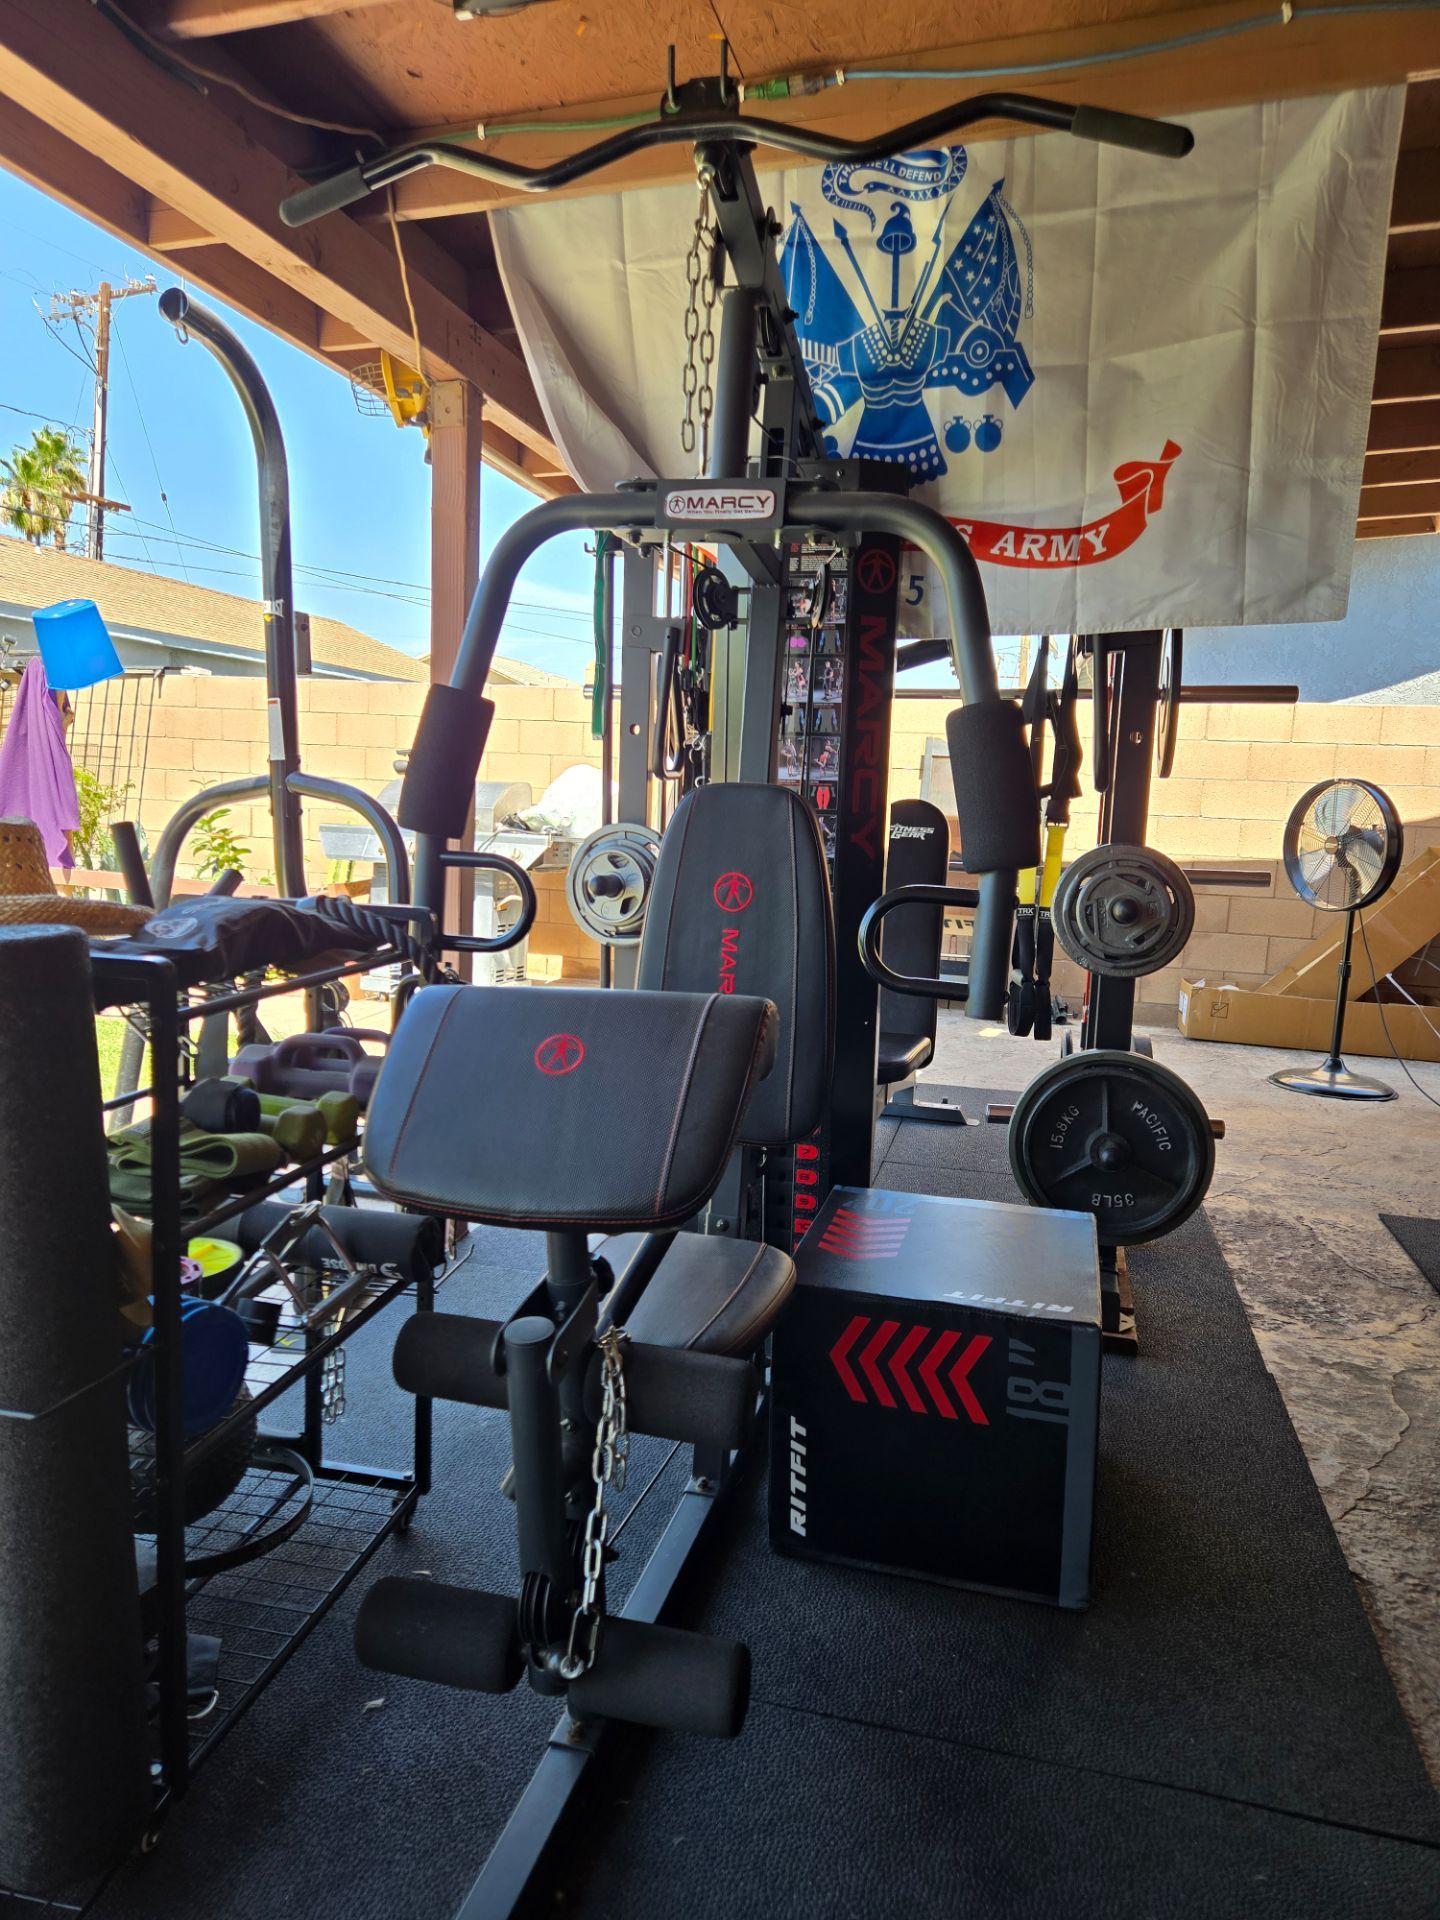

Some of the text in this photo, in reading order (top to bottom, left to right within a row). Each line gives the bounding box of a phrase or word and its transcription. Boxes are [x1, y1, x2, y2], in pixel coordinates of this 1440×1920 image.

[898, 165, 942, 182] DEFEND
[687, 495, 771, 509] MARCY
[990, 523, 1111, 562] ARMY
[851, 615, 888, 861] MARCY
[890, 831, 925, 840] GEAR
[1017, 907, 1034, 915] TRX
[719, 928, 740, 994] MAR
[1050, 1105, 1080, 1149] 15.8KG
[1131, 1100, 1172, 1151] PACIFIC
[1091, 1193, 1135, 1208] 35LB
[321, 1257, 378, 1274] DMOSE
[943, 1291, 1075, 1313] RITFIT
[790, 1415, 806, 1537] RITFIT
